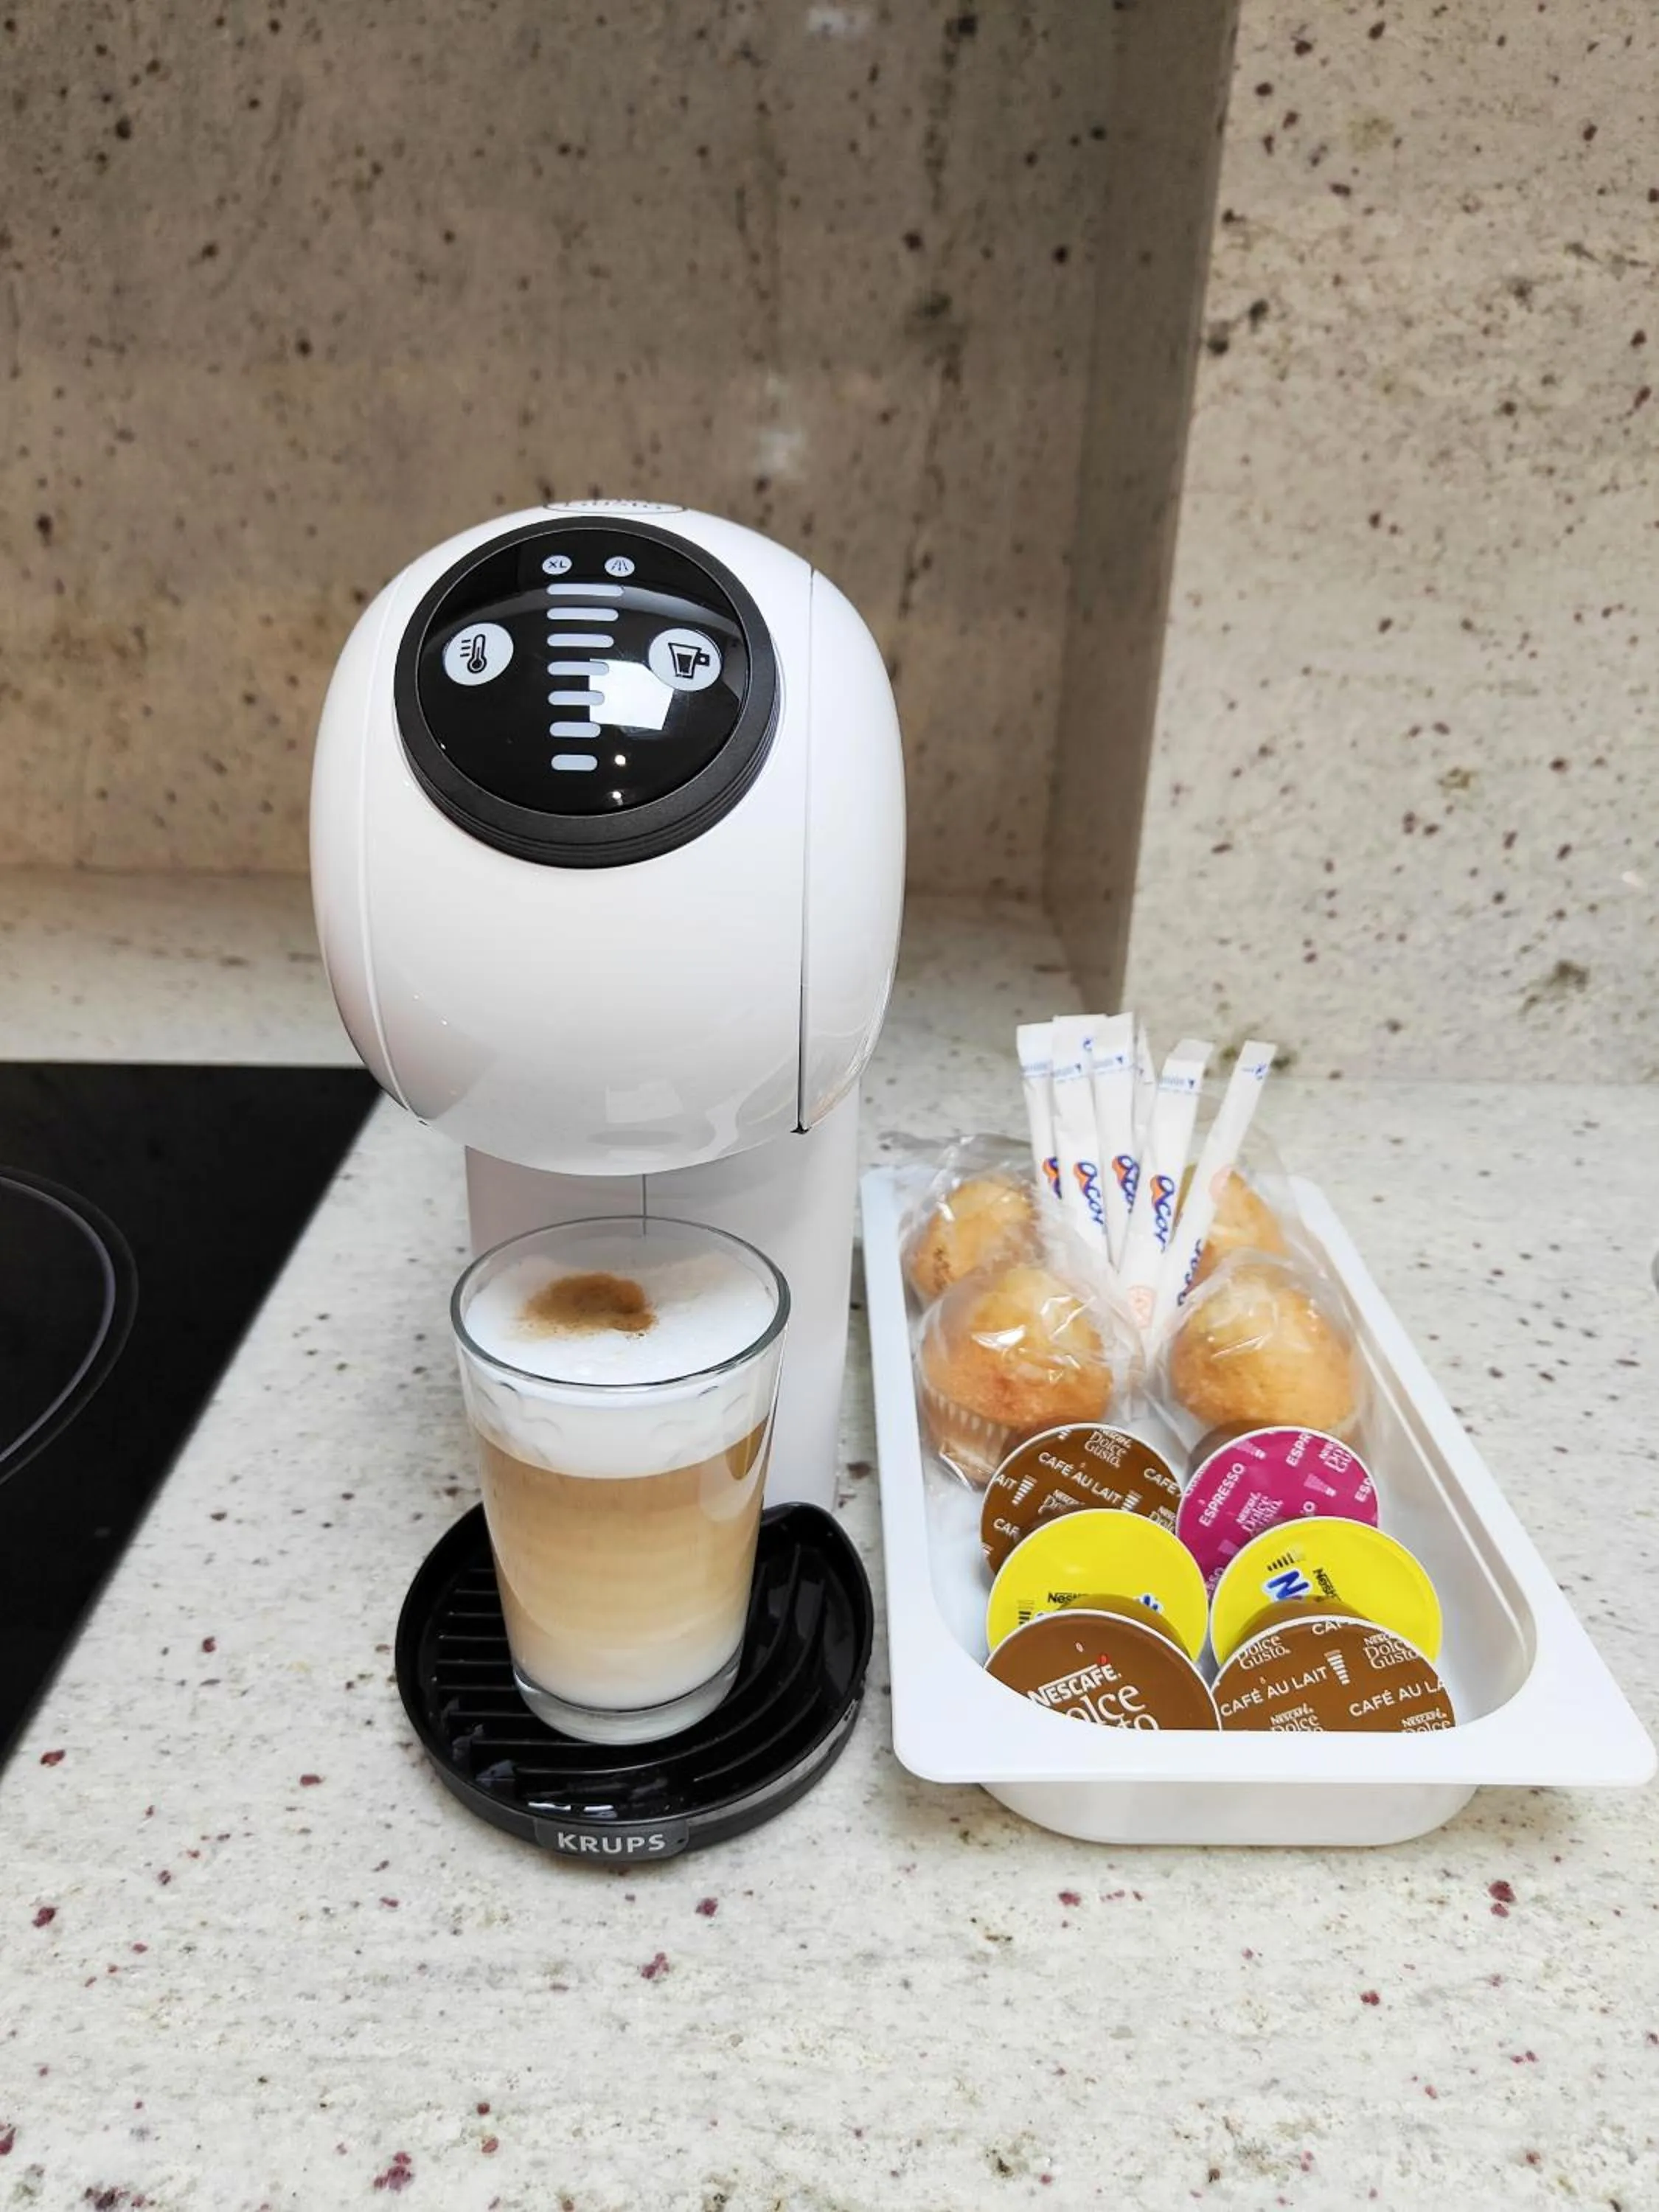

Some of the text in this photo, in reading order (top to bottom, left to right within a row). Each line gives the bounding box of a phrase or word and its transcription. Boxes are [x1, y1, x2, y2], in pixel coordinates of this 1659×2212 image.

[549, 560, 567, 568] XL
[1071, 1471, 1093, 1489] AU
[1091, 1481, 1124, 1506] LAIT
[1199, 1463, 1246, 1527] ESPRESSO
[1220, 1666, 1328, 1717] CAFÉ AU LAIT
[1349, 1689, 1396, 1717] CAFÉ
[1398, 1683, 1422, 1702] AU
[557, 1832, 666, 1853] KRUPS
